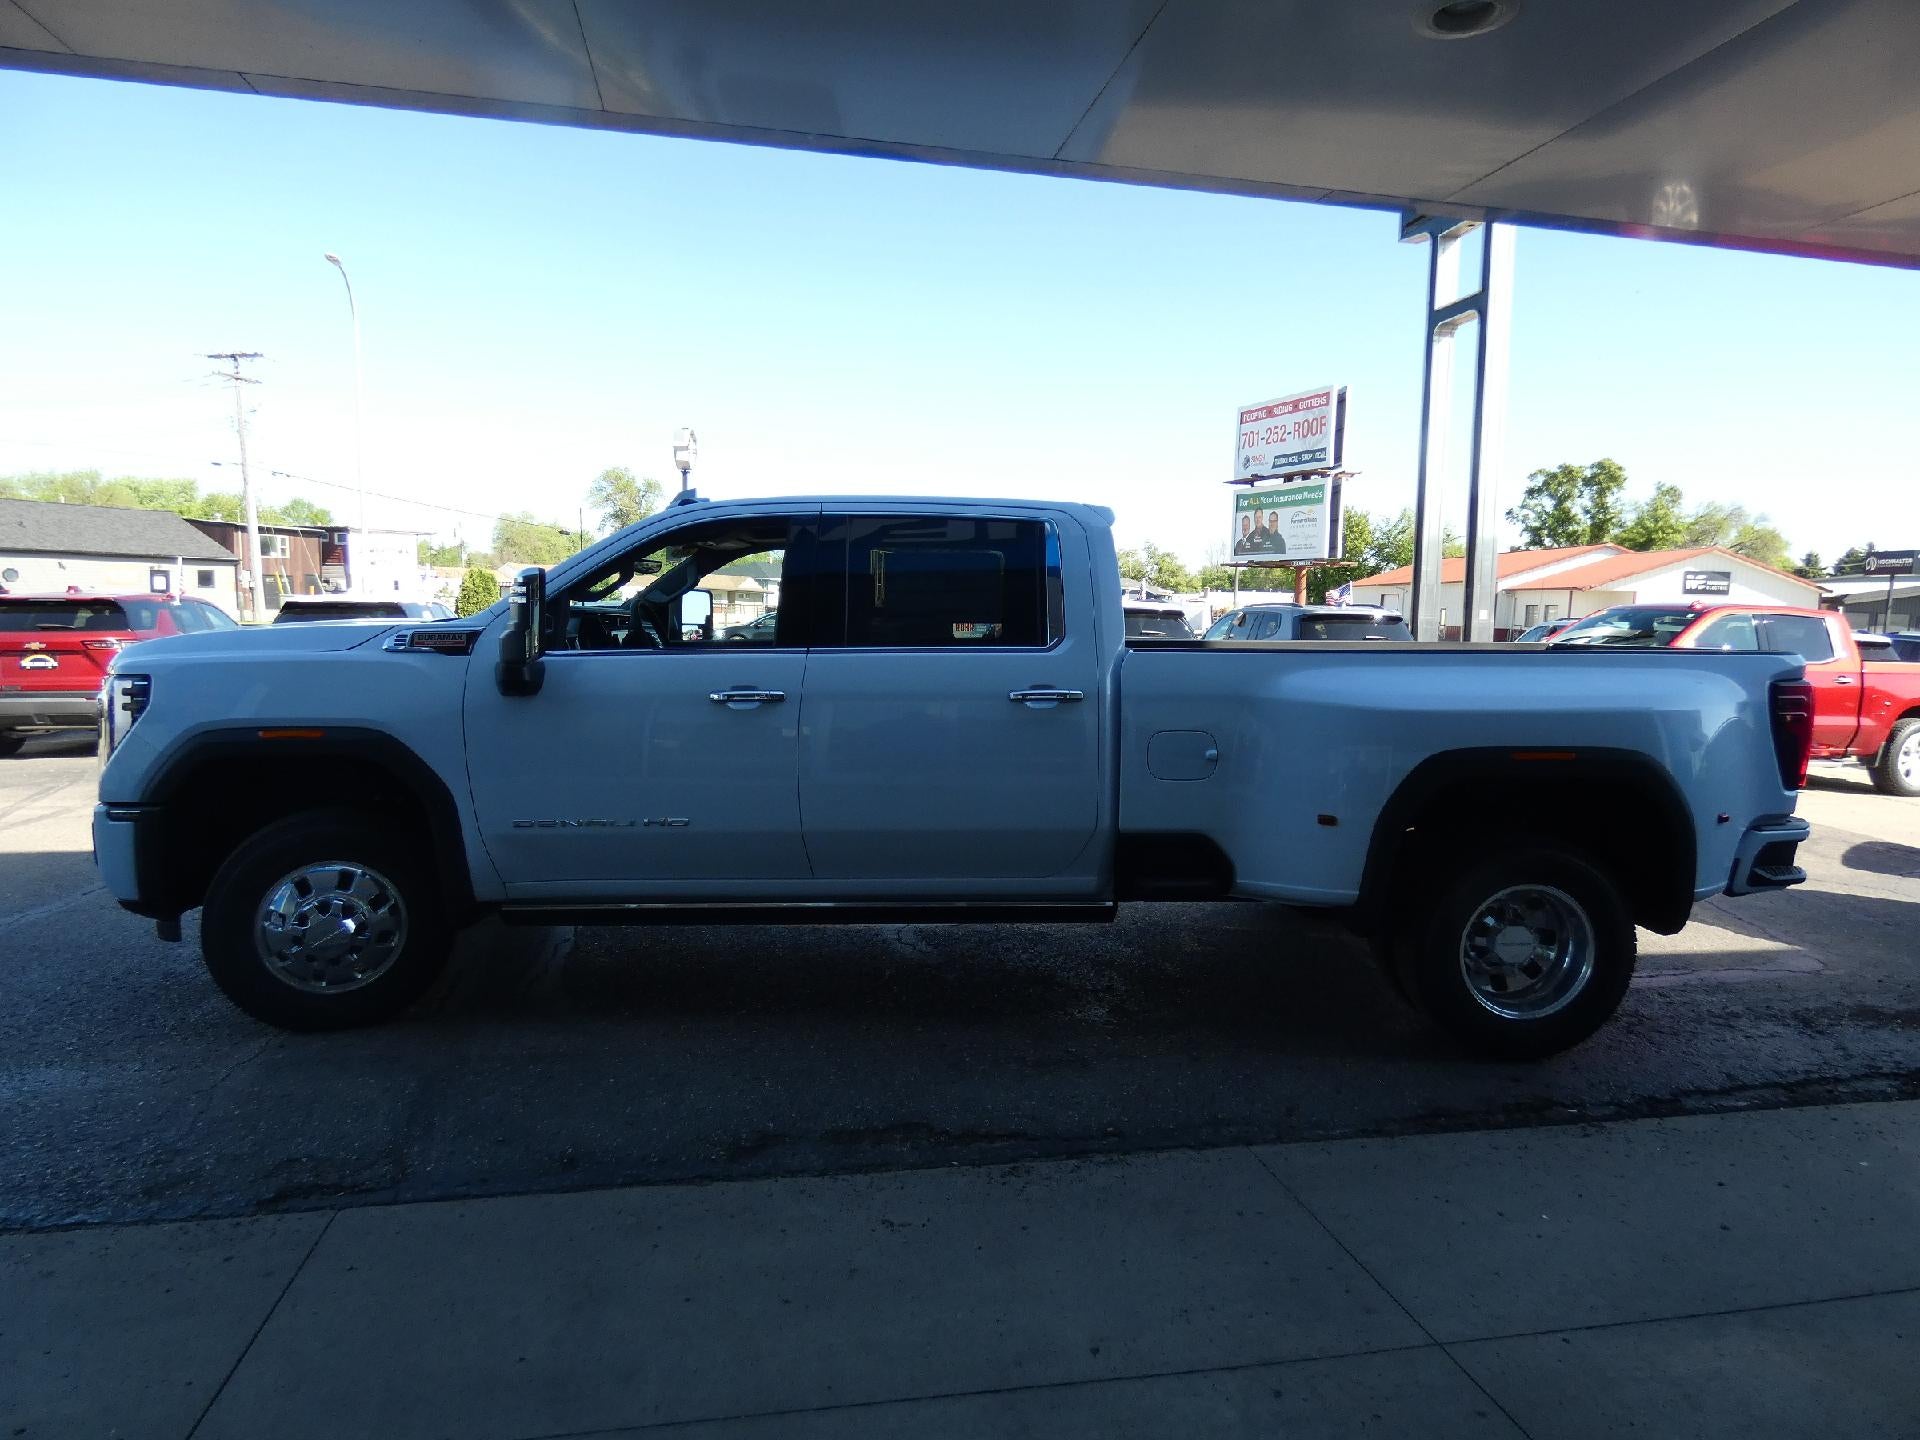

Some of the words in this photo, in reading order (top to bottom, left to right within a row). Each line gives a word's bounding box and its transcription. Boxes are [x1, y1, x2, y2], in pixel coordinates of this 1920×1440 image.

[1241, 415, 1327, 449] 701-252-ROOF
[1273, 493, 1302, 503] Insurance
[1302, 489, 1323, 499] Needs
[417, 633, 464, 641] DURAMAX
[512, 819, 636, 828] DENALI
[642, 818, 690, 828] HD
